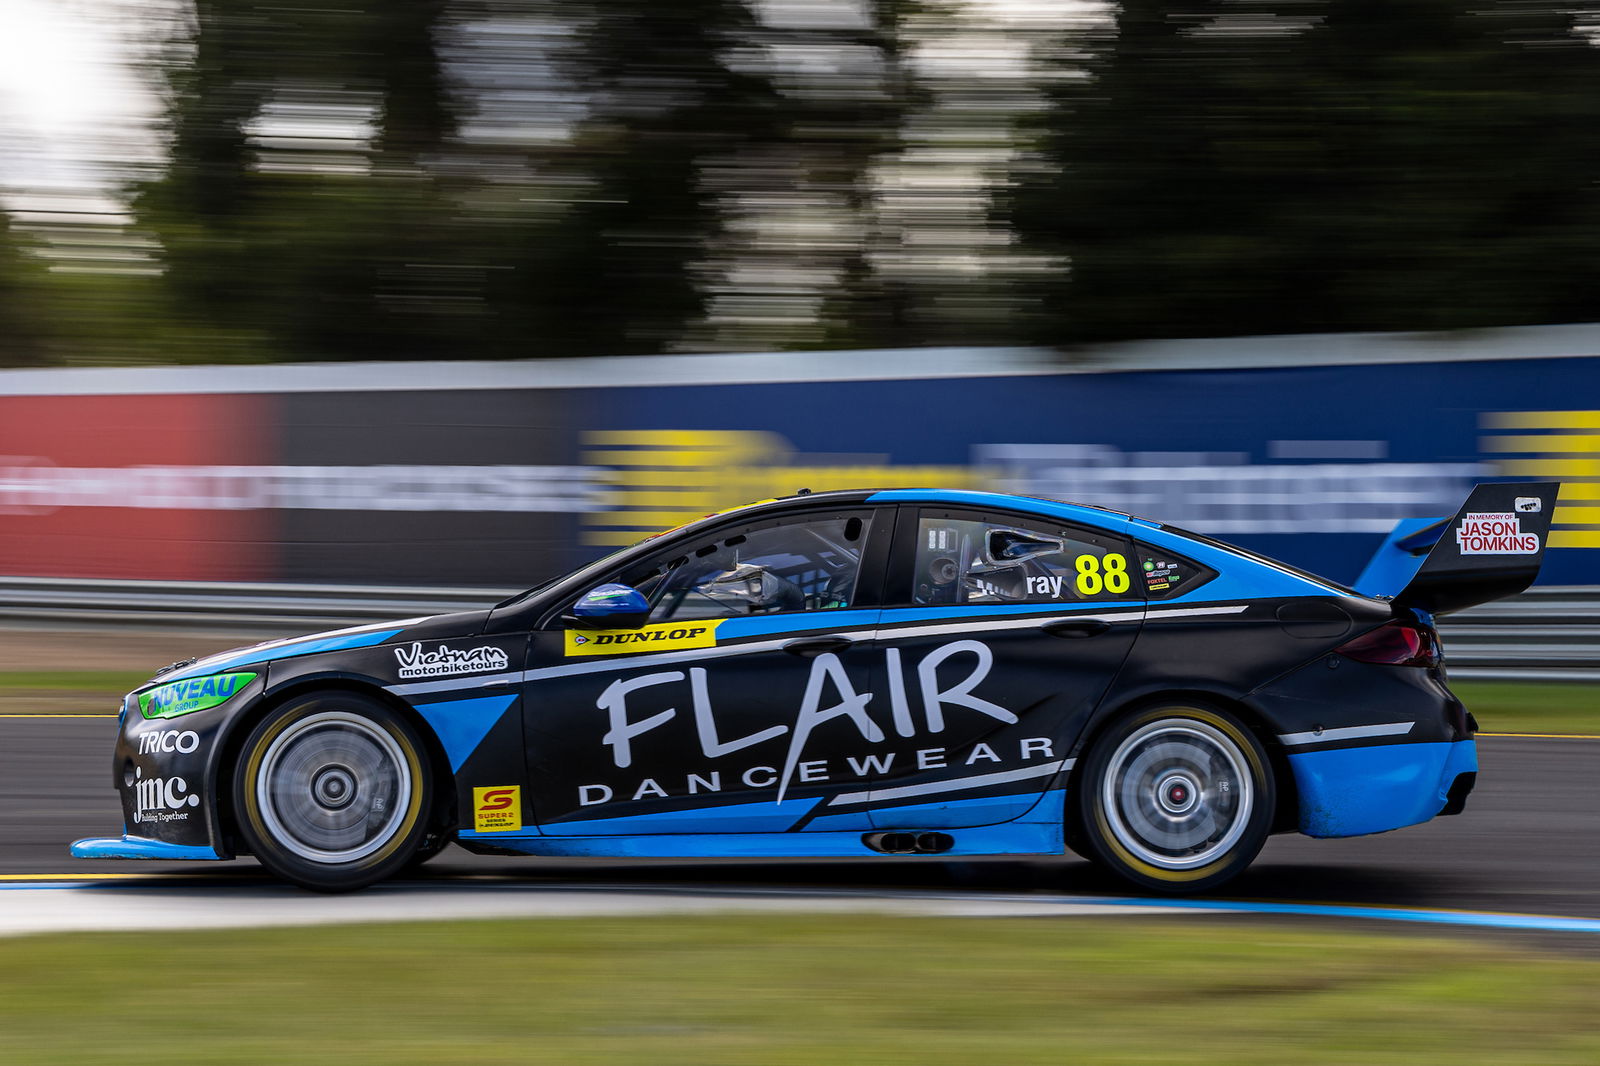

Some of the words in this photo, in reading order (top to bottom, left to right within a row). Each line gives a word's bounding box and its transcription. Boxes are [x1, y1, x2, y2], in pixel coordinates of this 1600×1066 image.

[1460, 522, 1517, 536] JASON
[1460, 537, 1536, 551] TOMKINS
[1075, 553, 1130, 595] 88
[593, 627, 707, 645] DUNLOP
[396, 642, 507, 666] Vietnam
[401, 659, 505, 677] motorbiketours
[174, 700, 199, 712] GROUP
[597, 639, 1019, 805] FLAIR
[138, 730, 200, 755] TRICO
[578, 736, 1055, 807] DANCEWEAR
[158, 811, 188, 823] Together
